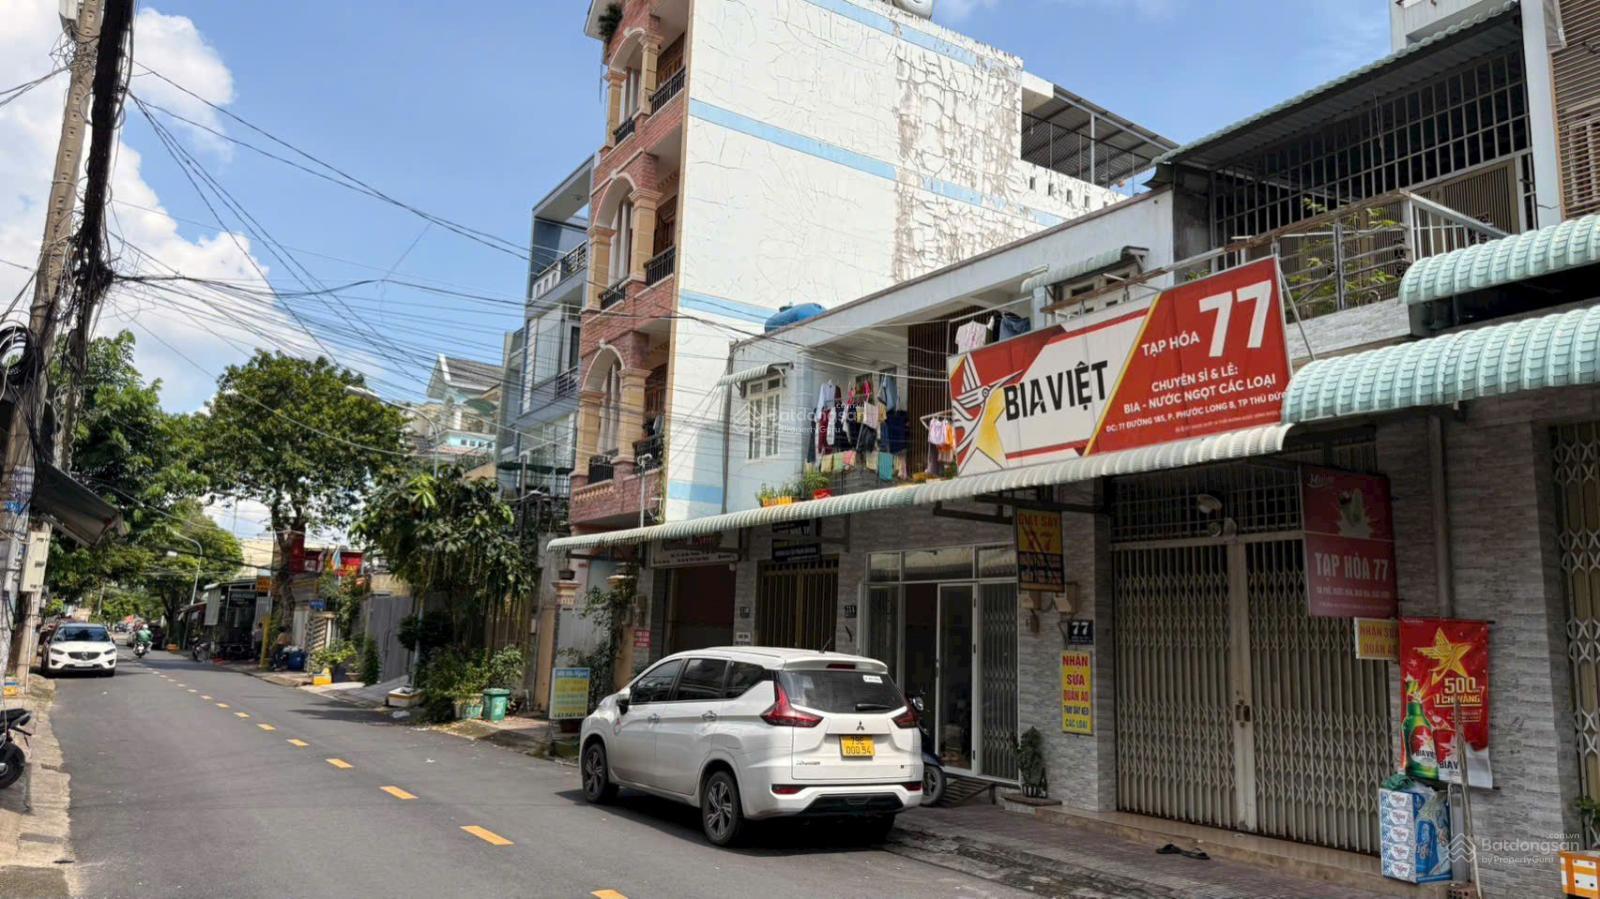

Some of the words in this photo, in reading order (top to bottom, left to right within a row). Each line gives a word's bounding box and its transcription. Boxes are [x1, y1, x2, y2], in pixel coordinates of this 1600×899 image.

[1141, 340, 1167, 357] TẠP
[1169, 331, 1200, 349] HÓA
[1198, 279, 1272, 358] 77
[1151, 372, 1196, 392] CHUYÊN
[1210, 368, 1219, 380] &
[1123, 402, 1141, 414] BIA
[1148, 393, 1182, 409] NƯỚC
[1184, 386, 1216, 401] NGỌT
[1218, 379, 1245, 394] CÁC
[1247, 374, 1276, 389] LOẠI
[1205, 402, 1228, 413] LONG
[1238, 398, 1249, 407] TP
[1314, 552, 1340, 582] TẠP
[1373, 558, 1389, 582] 77
[1072, 621, 1089, 636] 77
[1444, 676, 1476, 694] 500
